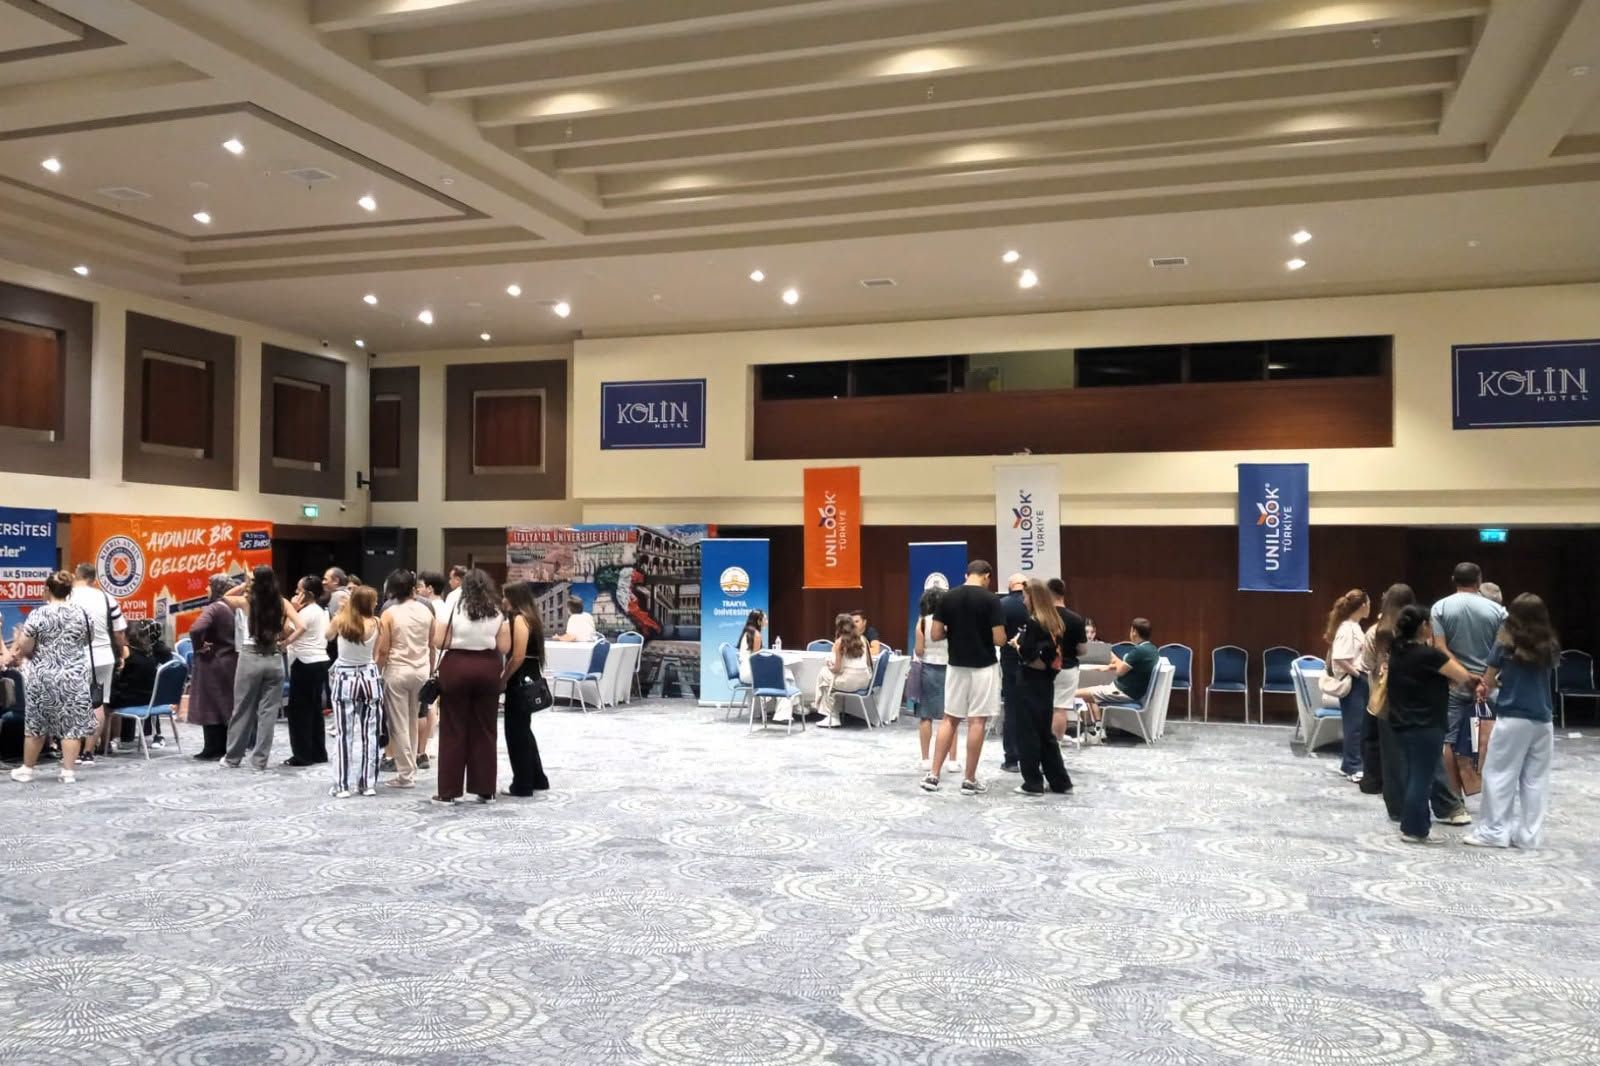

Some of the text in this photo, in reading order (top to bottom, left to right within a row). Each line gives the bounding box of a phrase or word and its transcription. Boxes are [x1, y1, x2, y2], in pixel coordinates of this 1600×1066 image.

[1537, 394, 1588, 402] HOTEL
[208, 522, 233, 546] BİR
[599, 529, 628, 541] EĞİTİMİ
[839, 509, 847, 550] TÜRKİYE
[1035, 510, 1045, 553] TÜRKİYE
[1282, 506, 1292, 552] TÜRKİYE
[15, 570, 20, 579] 5
[123, 600, 147, 609] AYDIN
